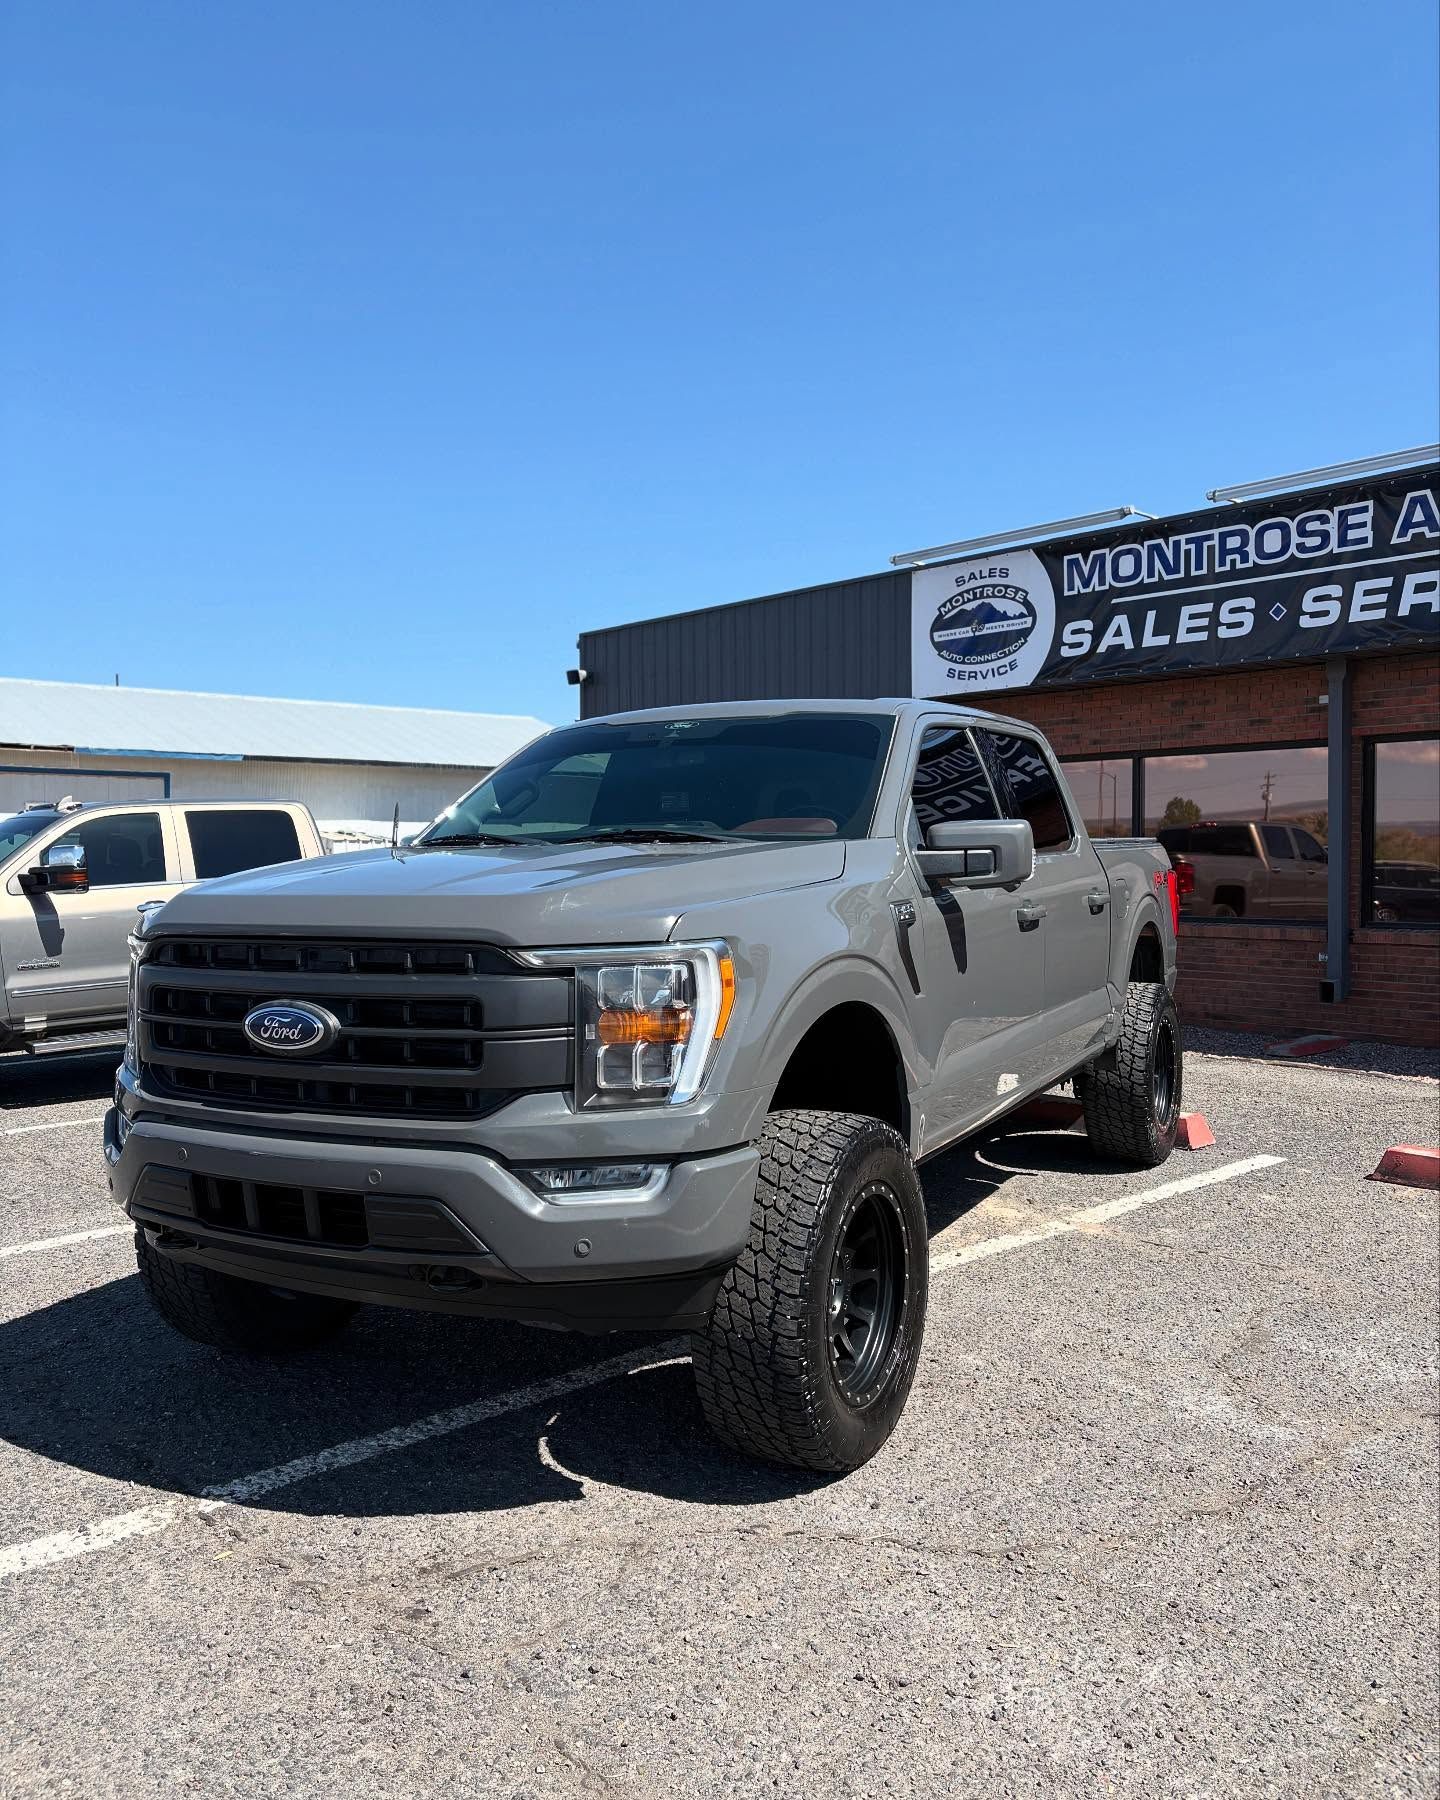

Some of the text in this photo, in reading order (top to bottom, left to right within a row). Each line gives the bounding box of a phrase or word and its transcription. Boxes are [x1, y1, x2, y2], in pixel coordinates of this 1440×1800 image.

[1063, 489, 1440, 597] MONTROSE A
[954, 567, 1010, 588] SALES
[939, 586, 1027, 616] MONTROSE
[1006, 620, 1028, 628] DRIVER
[1060, 570, 1440, 658] SALES SER
[940, 637, 1025, 663] AUTO CONNECTION
[946, 659, 1018, 681] SERVICE
[260, 1016, 302, 1040] Ford
